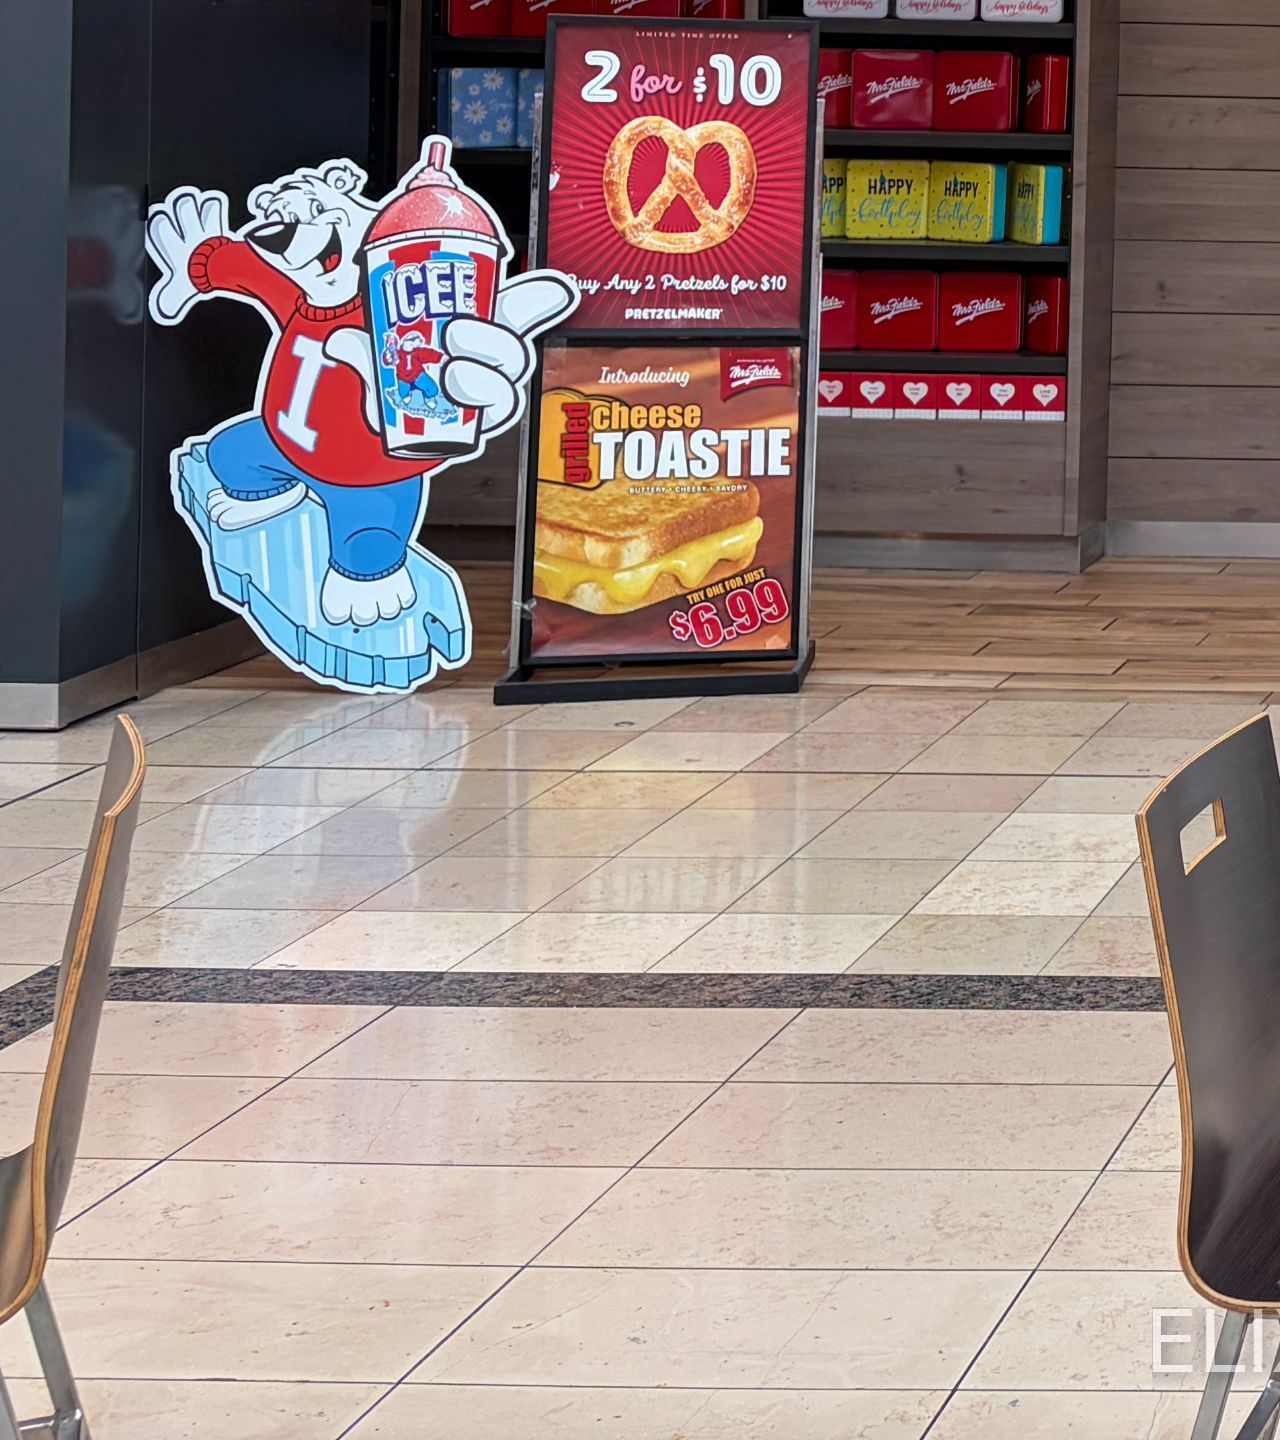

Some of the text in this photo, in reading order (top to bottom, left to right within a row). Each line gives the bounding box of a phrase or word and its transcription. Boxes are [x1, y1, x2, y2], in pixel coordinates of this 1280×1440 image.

[581, 49, 782, 107] 2 for $10
[868, 174, 913, 195] HAPPY
[944, 177, 979, 199] HAPPY
[381, 260, 477, 328] ICEE
[603, 273, 642, 296] Any
[644, 274, 656, 290] 2
[661, 273, 728, 292] Pretzels
[730, 275, 758, 296] for
[761, 275, 787, 292] $10
[624, 307, 720, 320] PRETZELMAKER
[598, 366, 690, 388] Introducing
[592, 401, 702, 430] cheese
[561, 403, 592, 484] grilled
[593, 428, 791, 481] TOASTIE
[629, 486, 667, 495] BUTTERY
[715, 484, 748, 493] SAVORY
[686, 567, 767, 605] TRY ONE FOR JUST
[669, 578, 789, 648] $6.99
